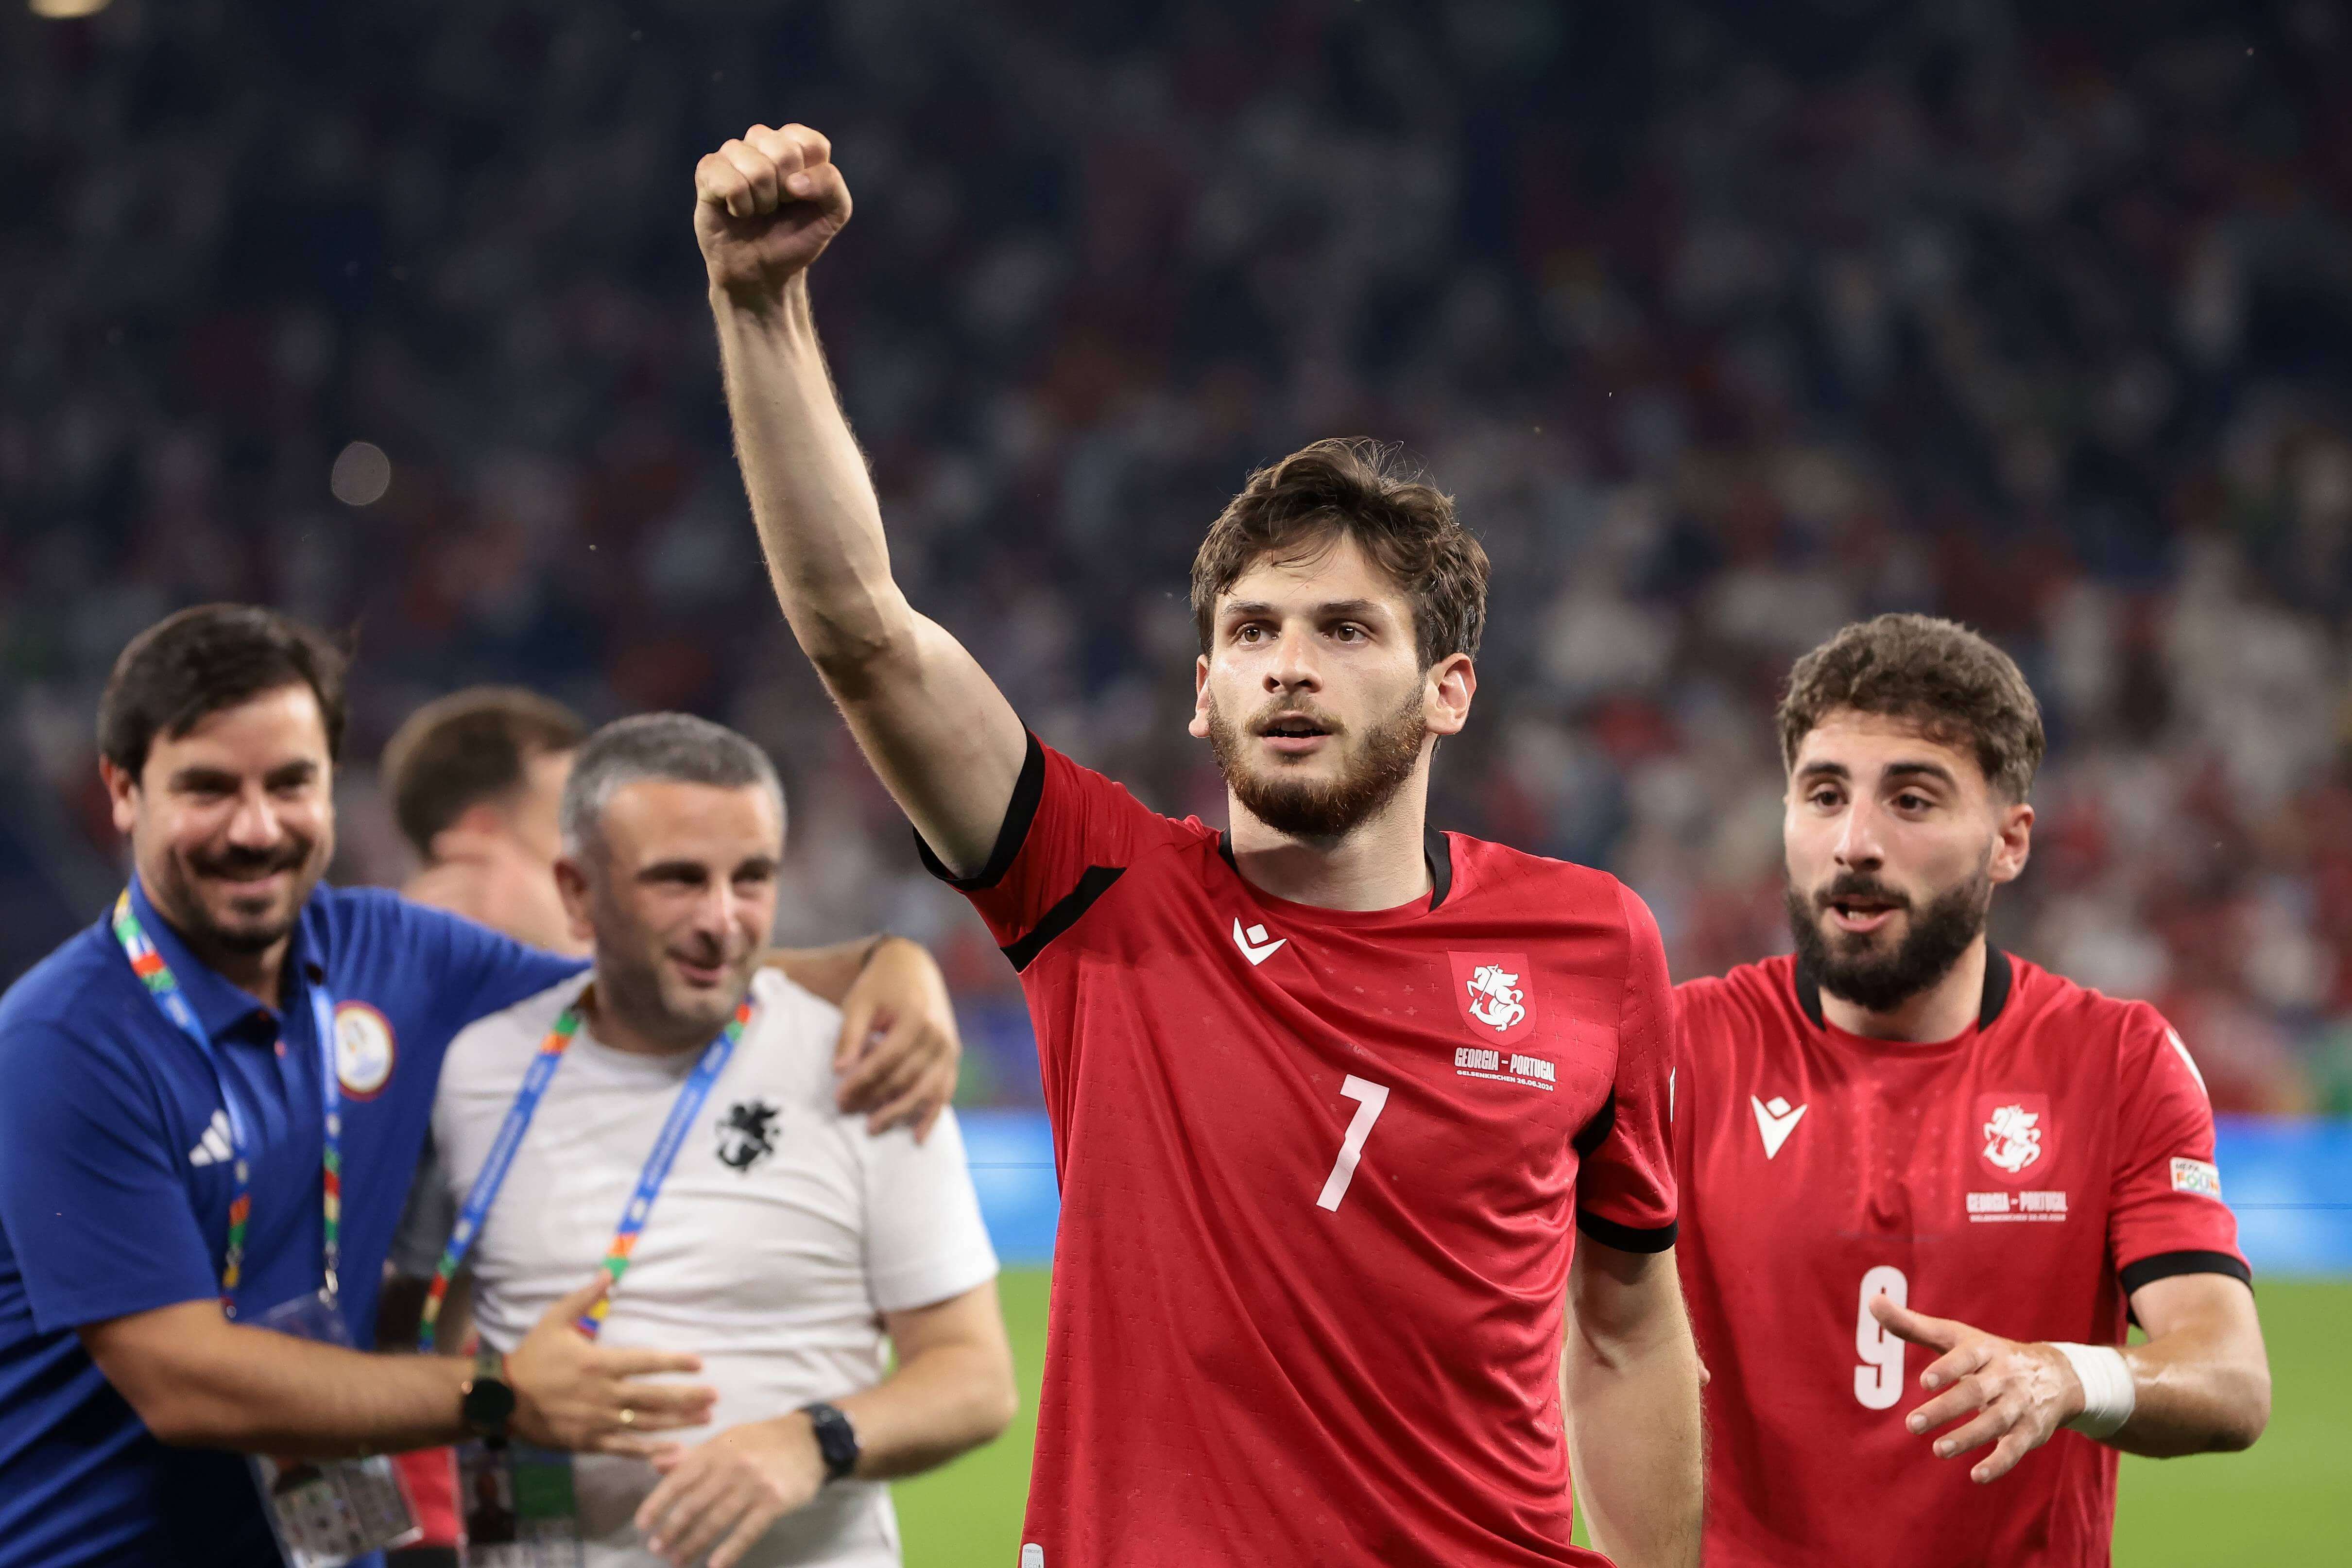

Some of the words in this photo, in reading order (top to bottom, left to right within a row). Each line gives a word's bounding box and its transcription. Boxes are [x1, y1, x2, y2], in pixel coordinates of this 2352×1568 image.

[1455, 1047, 1498, 1071] GEORGIA
[1510, 1053, 1556, 1082] PORTUGAL
[1457, 1070, 1516, 1083] GELSENKIRCHEN
[1516, 1077, 1554, 1092] 26.06.2024
[1316, 1073, 1390, 1212] 7
[1854, 1265, 1908, 1410] 9
